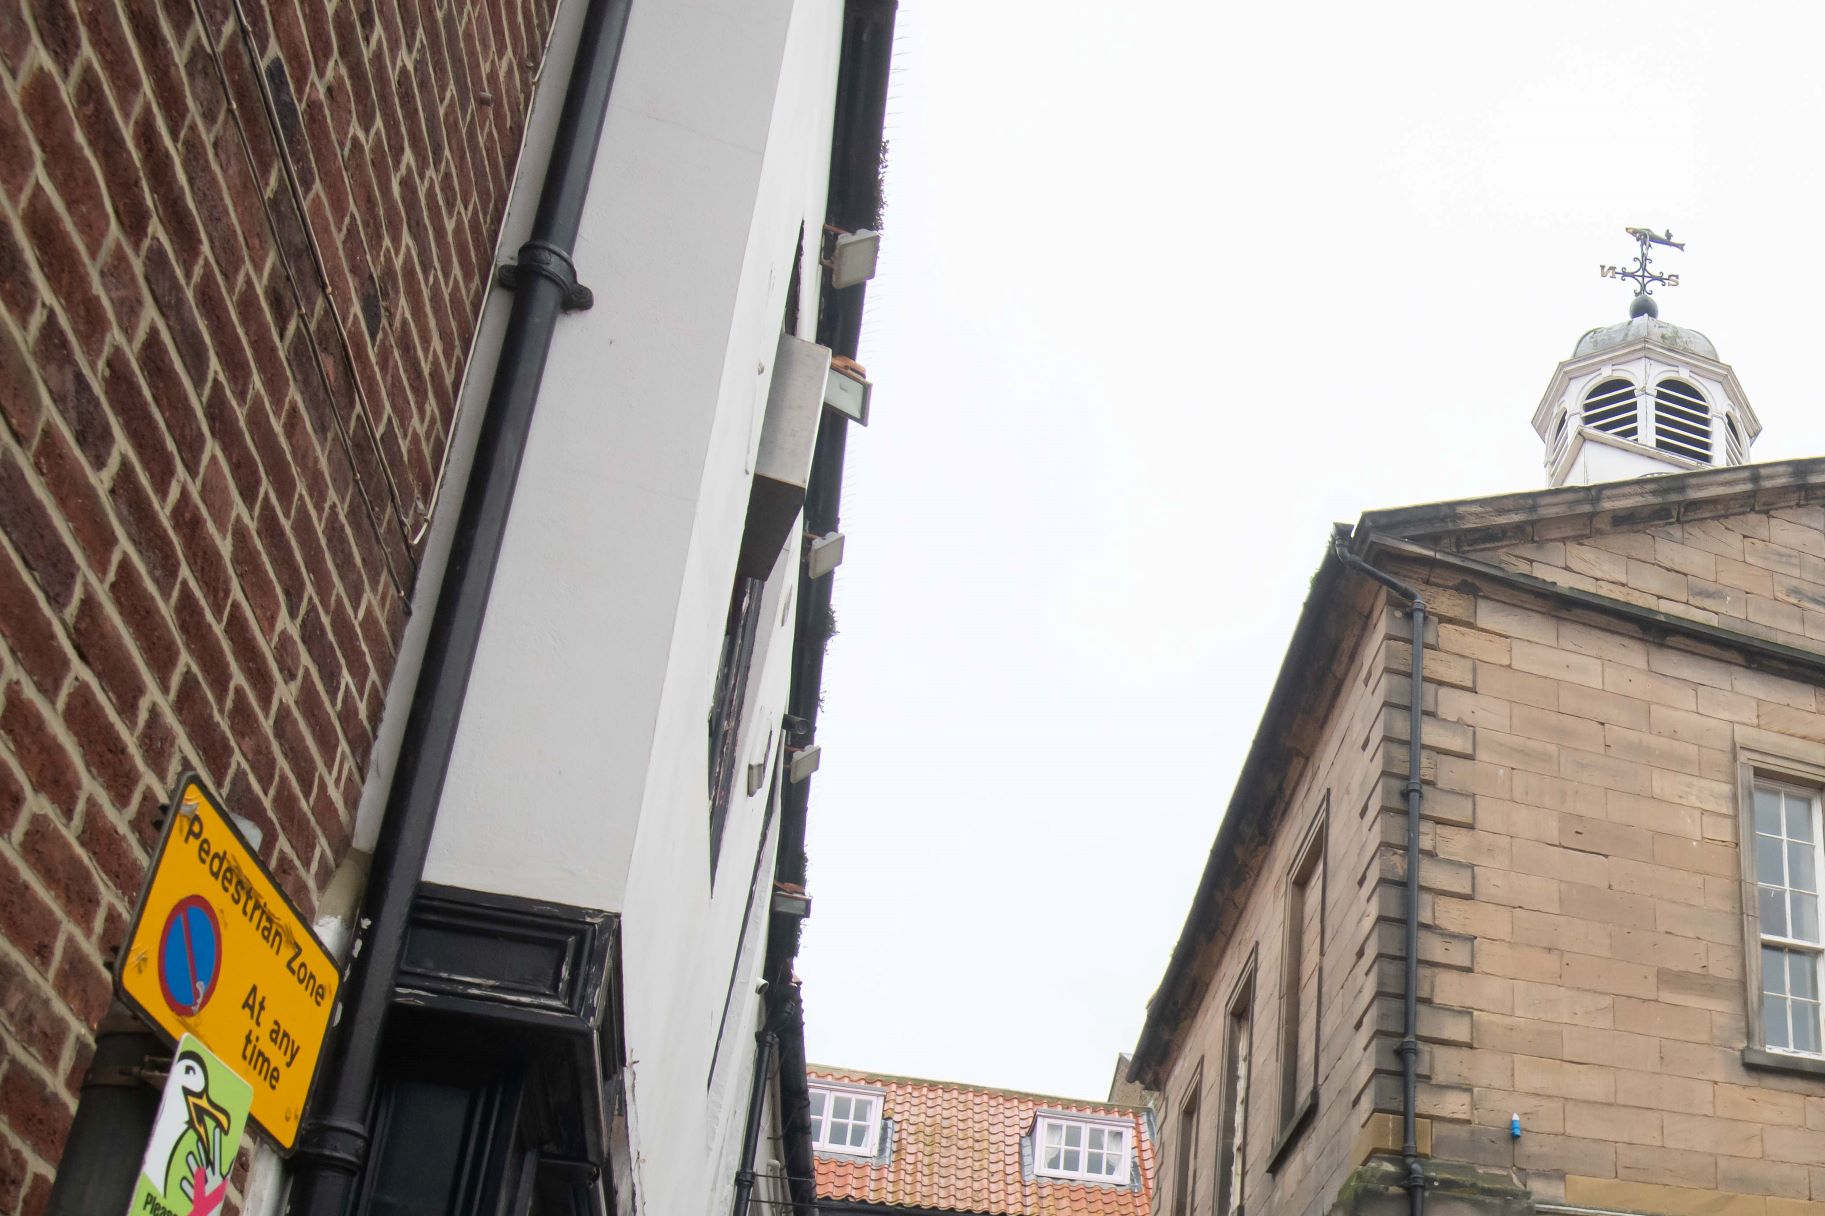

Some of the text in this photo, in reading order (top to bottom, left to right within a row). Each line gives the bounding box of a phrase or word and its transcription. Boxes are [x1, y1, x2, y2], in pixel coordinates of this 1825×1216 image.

[184, 813, 325, 1007] Pedestrian Zone
[241, 1029, 280, 1091] time
[242, 984, 300, 1069] At any
